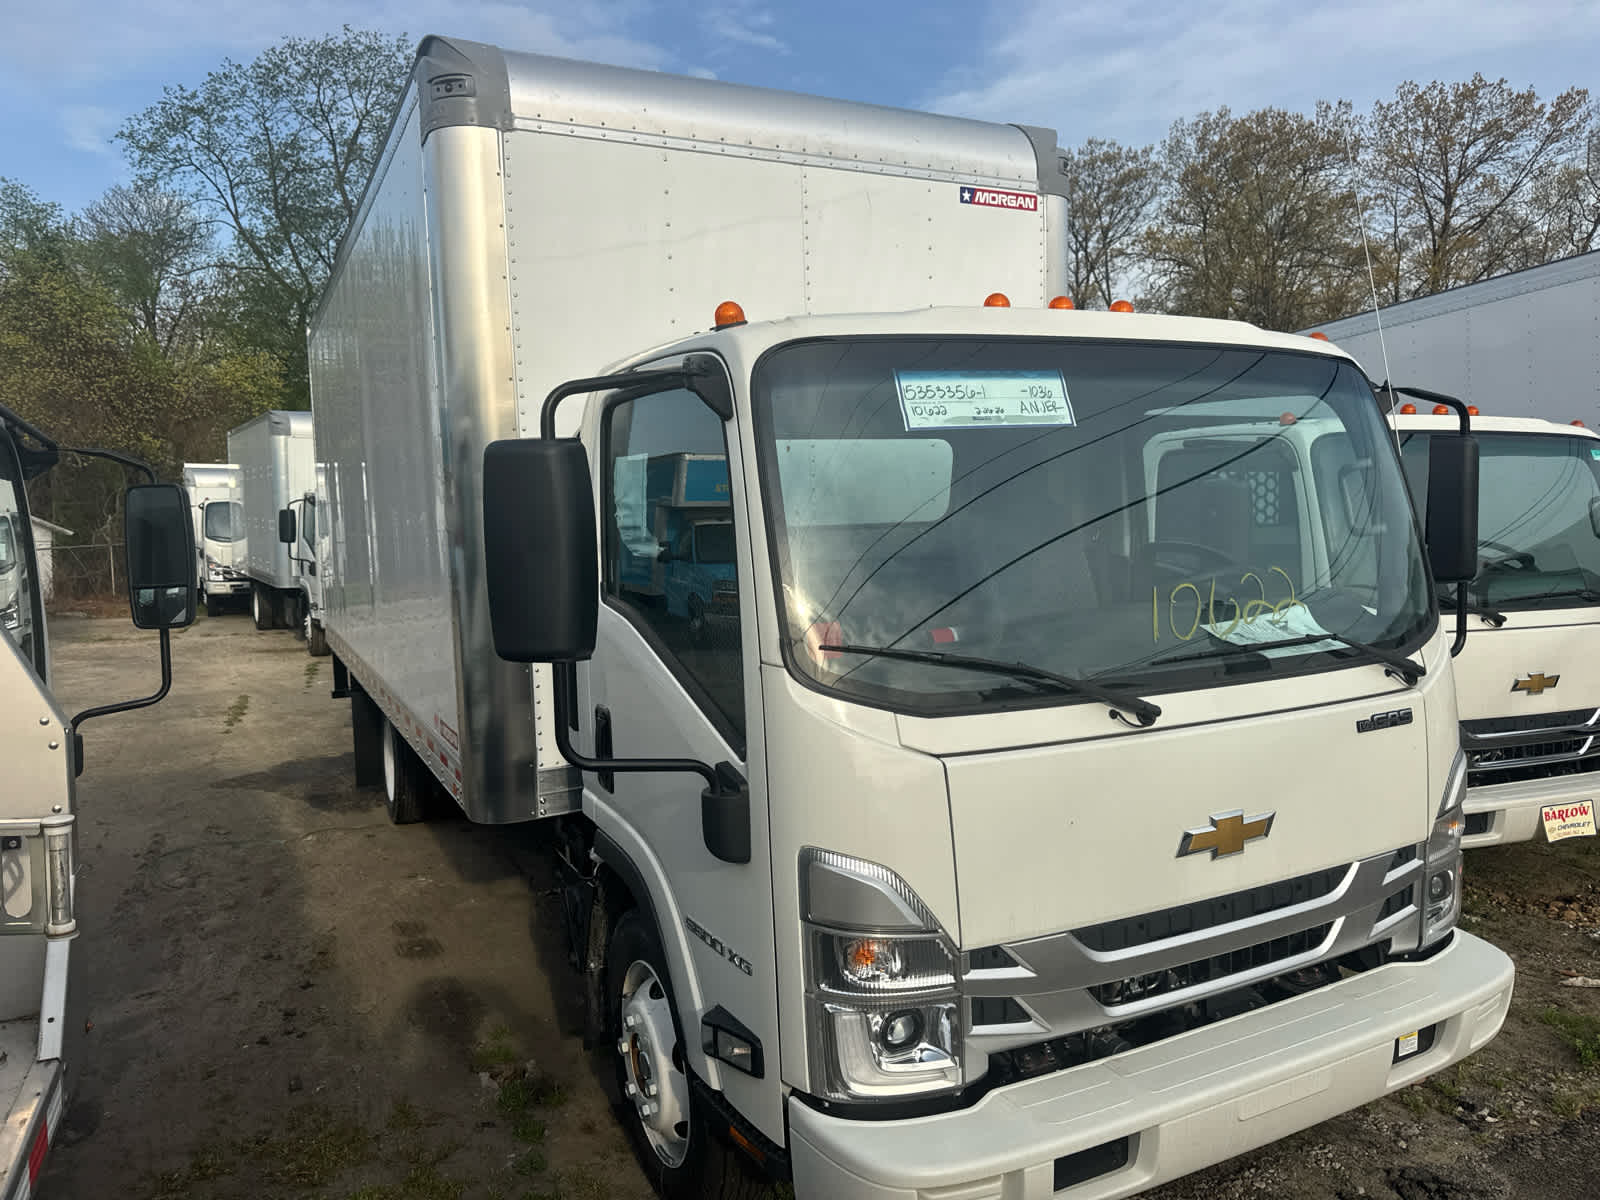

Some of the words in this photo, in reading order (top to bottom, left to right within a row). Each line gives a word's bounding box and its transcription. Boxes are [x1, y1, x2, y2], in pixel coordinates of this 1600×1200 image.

[974, 191, 1035, 209] MORGAN
[911, 405, 948, 417] 10622
[1152, 565, 1307, 644] 10622
[1544, 805, 1591, 823] BARLOW
